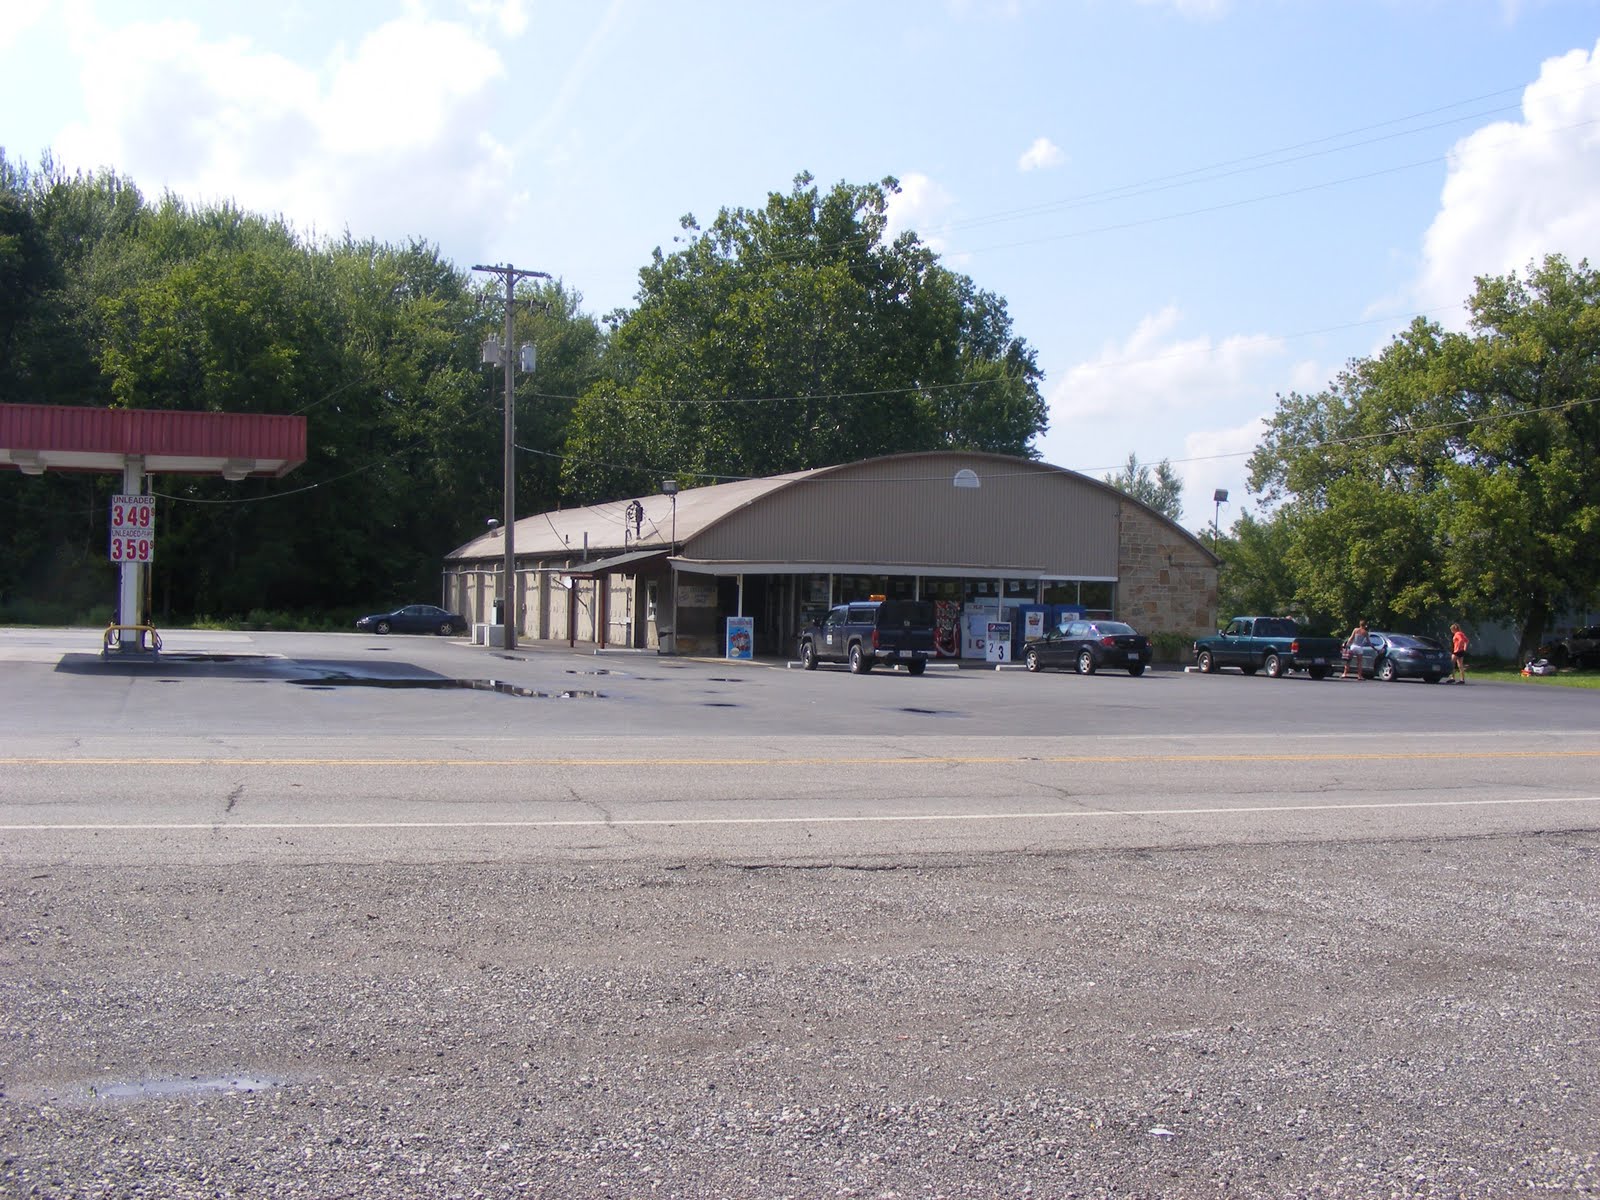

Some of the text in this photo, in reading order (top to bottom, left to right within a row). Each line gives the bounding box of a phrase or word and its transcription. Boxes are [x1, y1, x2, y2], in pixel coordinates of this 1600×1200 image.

[113, 496, 155, 505] UNLEADED
[112, 529, 141, 538] UNLEADED
[998, 645, 1004, 660] 3
